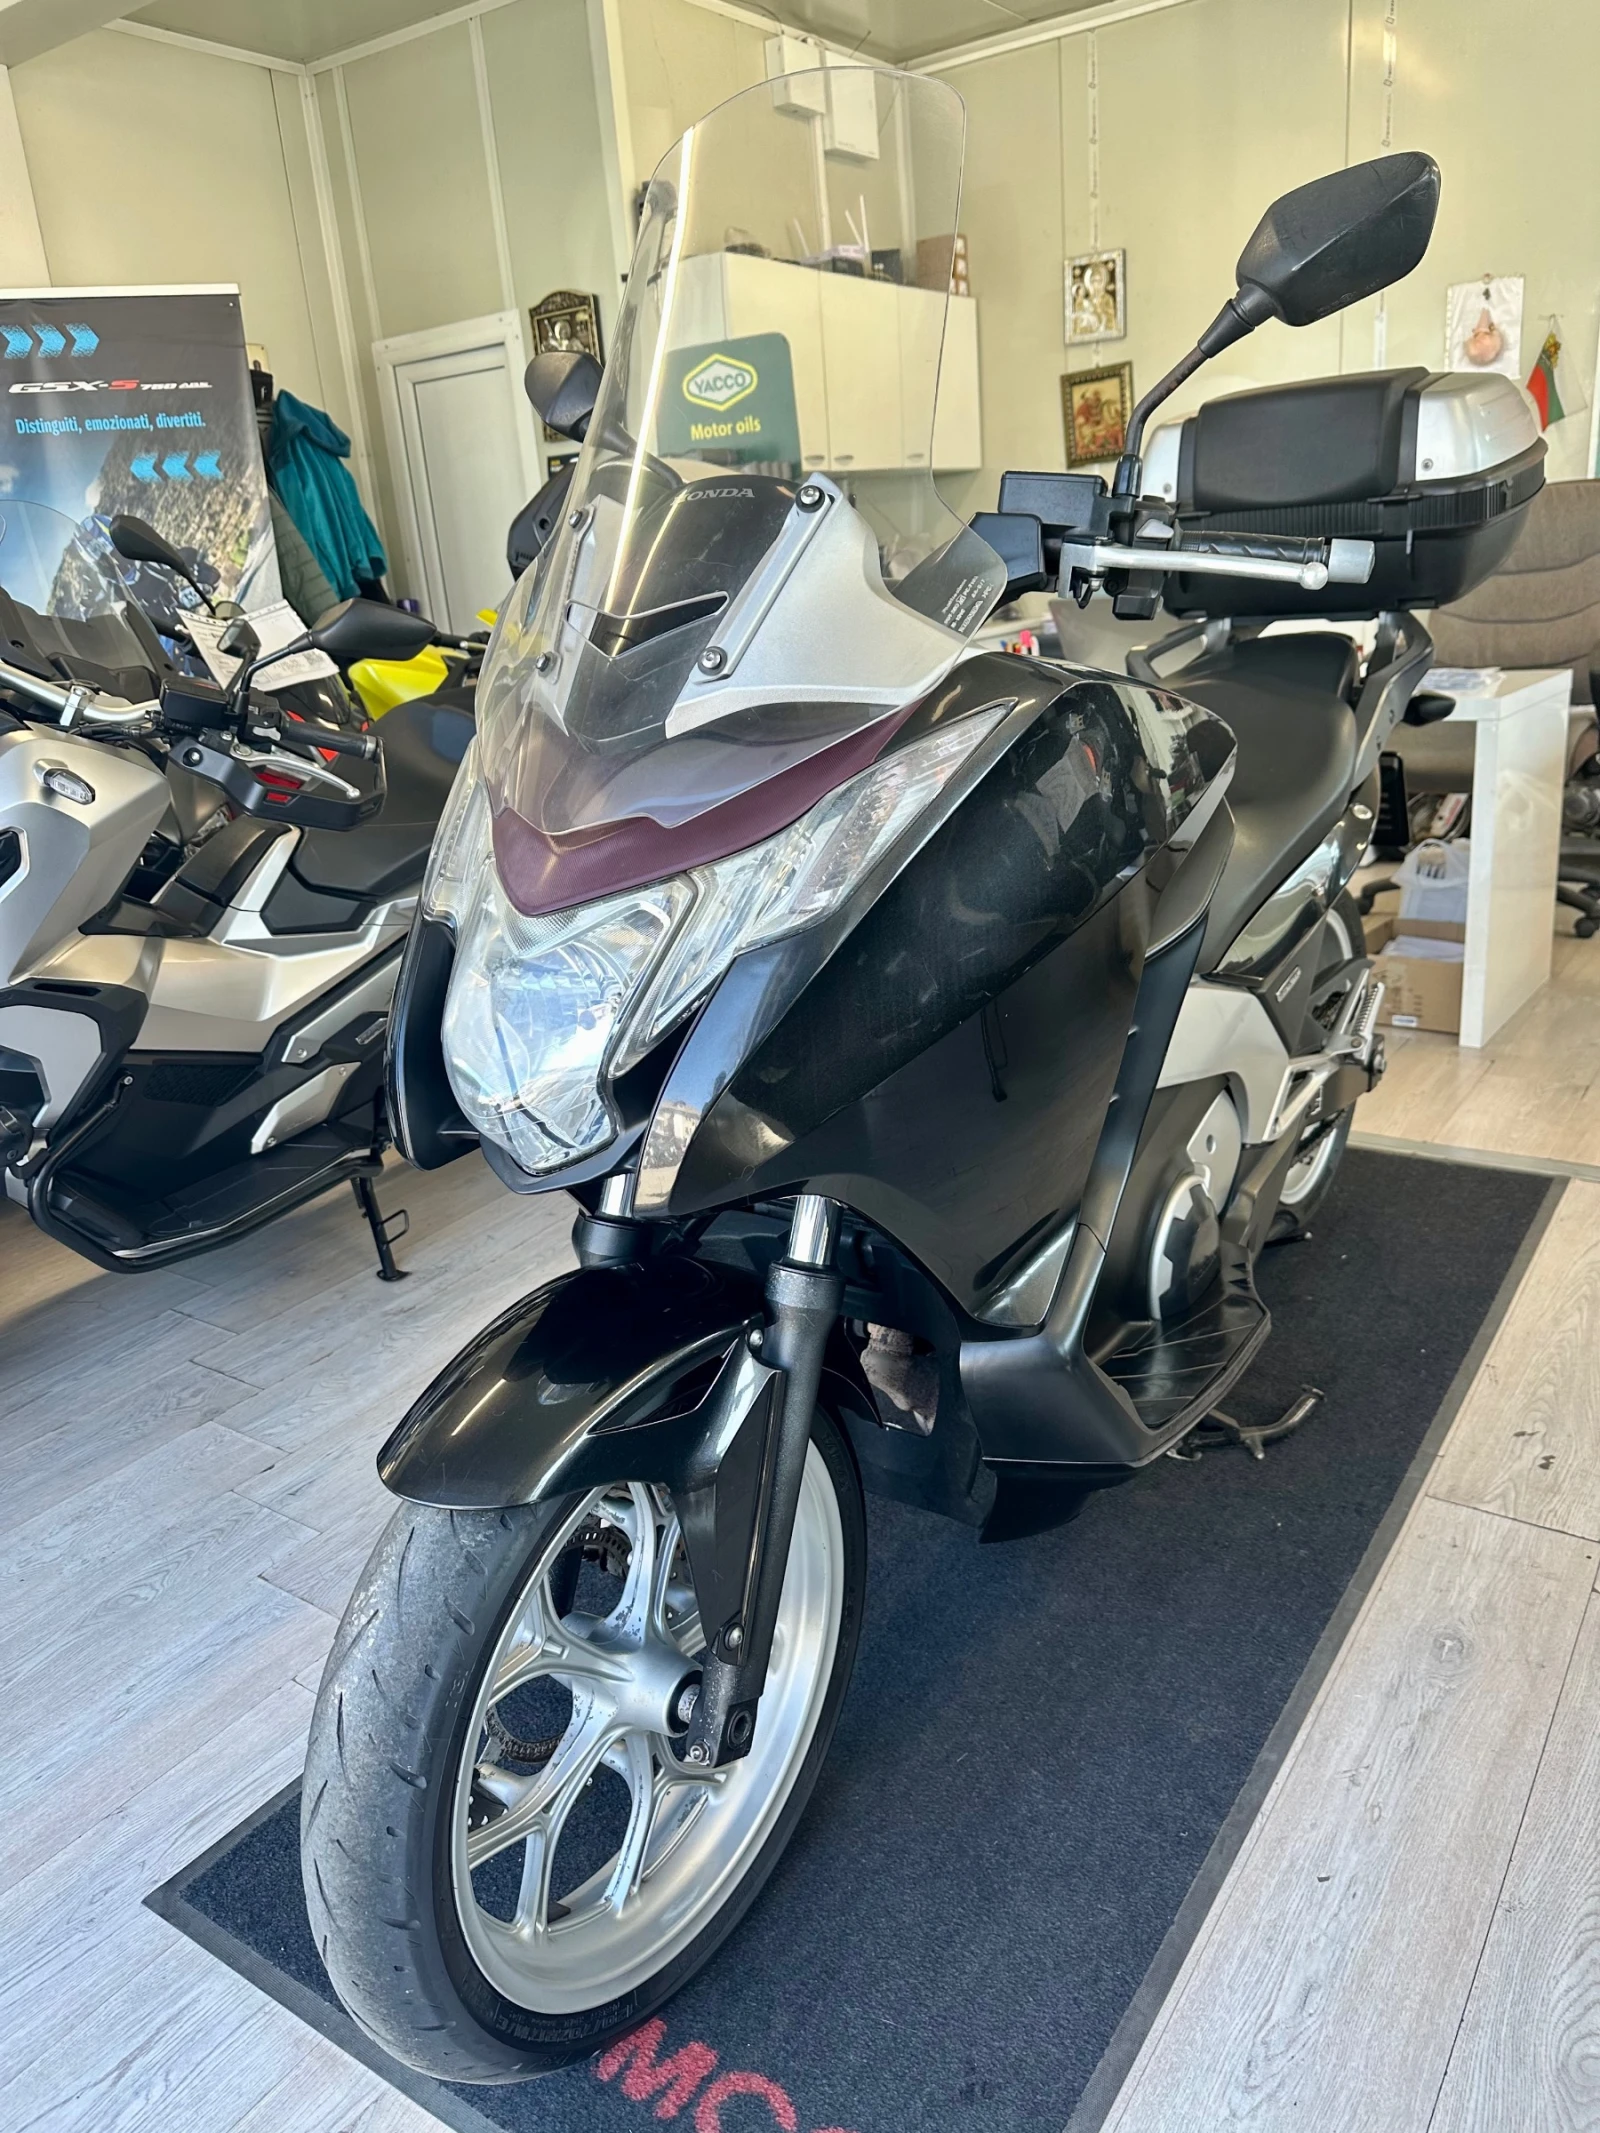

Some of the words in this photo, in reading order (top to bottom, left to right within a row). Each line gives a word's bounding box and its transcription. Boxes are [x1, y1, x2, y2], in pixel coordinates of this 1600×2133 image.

[8, 378, 140, 394] GSX-S
[694, 373, 746, 393] YACCO
[15, 417, 82, 436] Distinguiti,
[85, 413, 154, 432] emozionati,
[156, 411, 206, 429] divertiti.
[690, 422, 733, 441] Motor
[735, 415, 761, 434] oils
